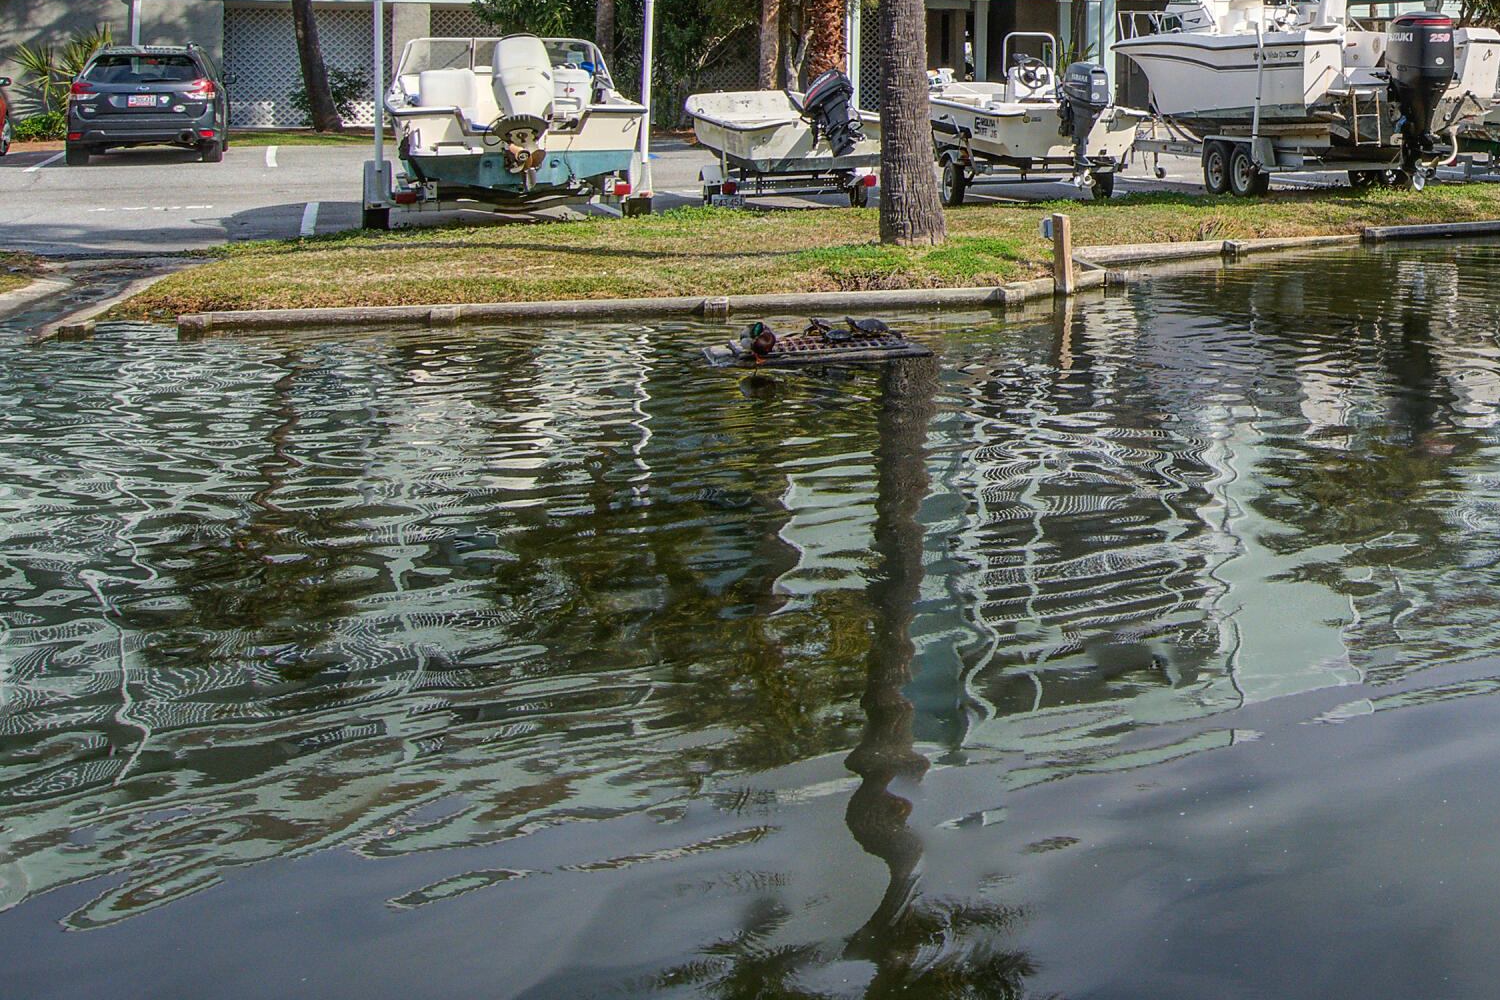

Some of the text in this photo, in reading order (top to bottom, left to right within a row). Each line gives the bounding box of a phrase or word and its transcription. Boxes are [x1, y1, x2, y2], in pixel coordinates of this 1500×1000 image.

[1387, 32, 1414, 42] SUZUKI
[1429, 33, 1451, 42] 250
[1071, 73, 1088, 82] YAMAHA
